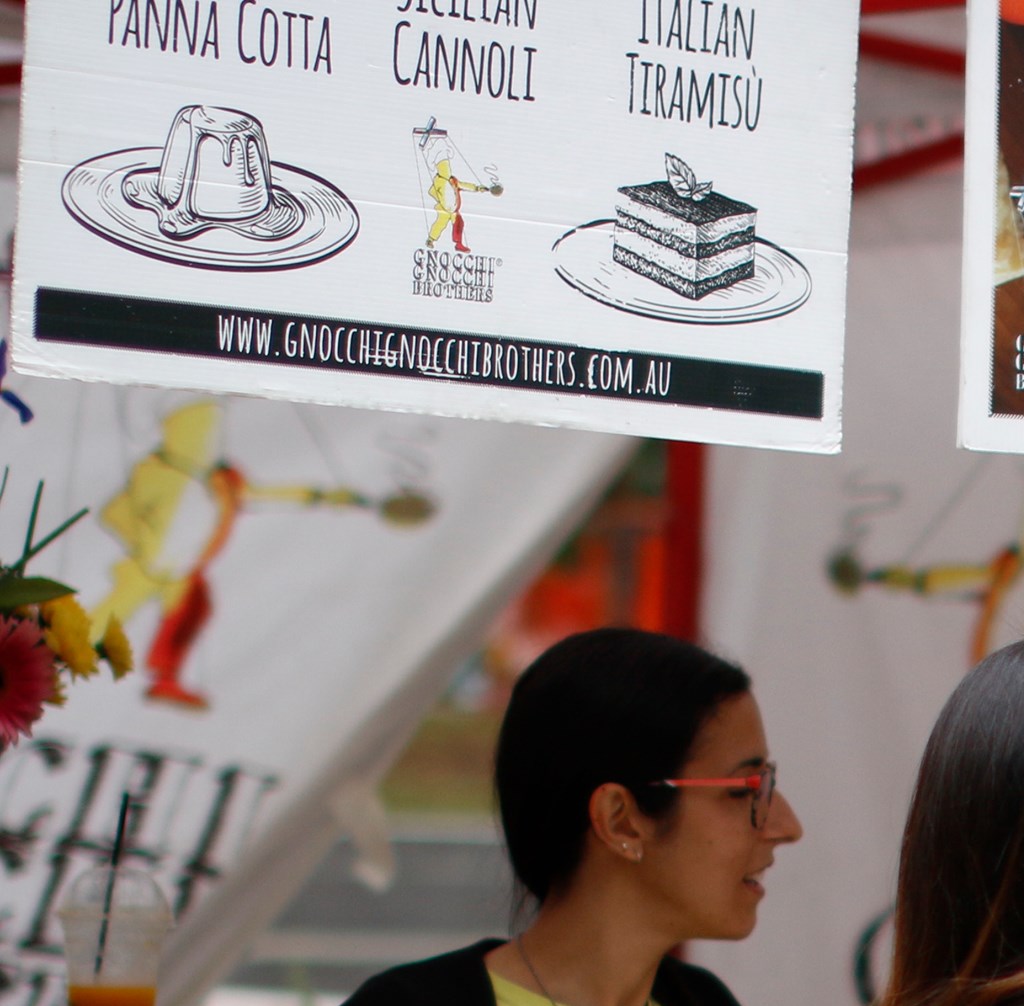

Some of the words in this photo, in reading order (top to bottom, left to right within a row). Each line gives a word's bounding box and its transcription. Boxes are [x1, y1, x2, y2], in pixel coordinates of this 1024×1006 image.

[107, 0, 219, 59] PANNA
[238, 0, 332, 74] COTTA
[393, 20, 537, 102] CANNOLI
[638, 0, 755, 60] ITALIAN
[625, 52, 763, 132] TIRAMISÙ
[412, 280, 493, 303] BROTHERS
[218, 314, 672, 397] WWW.GNOCCHIGNOCCHIBROTHERS.COM.AU
